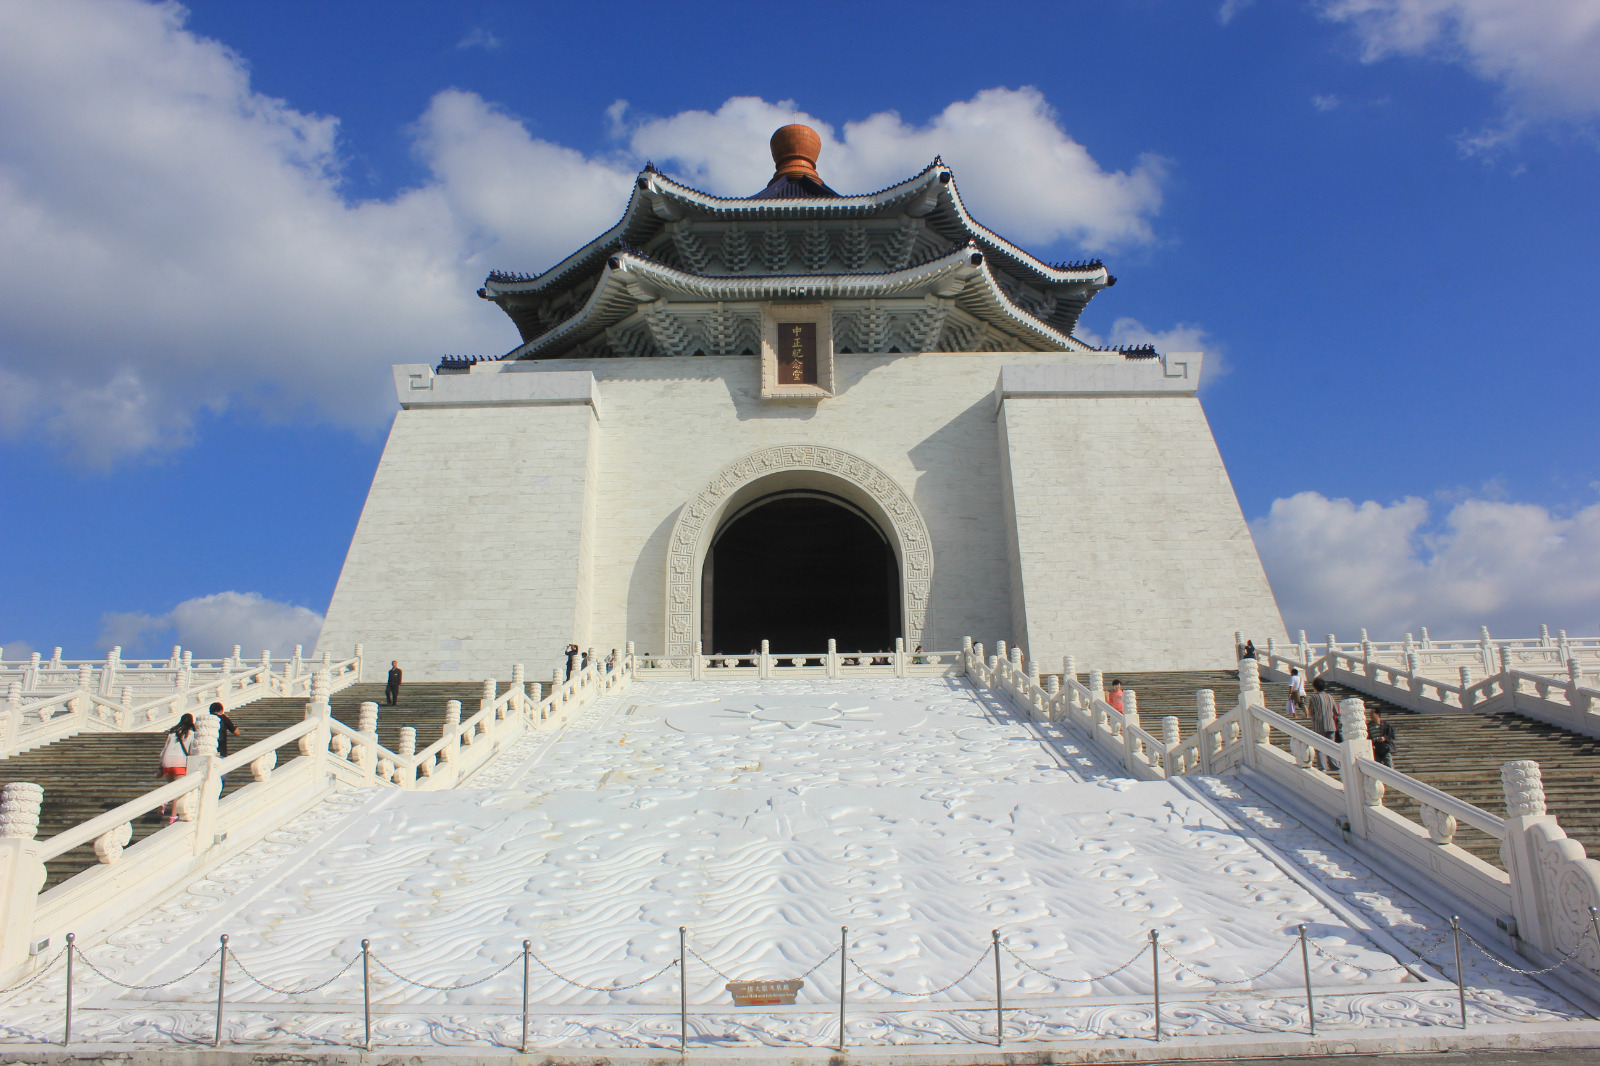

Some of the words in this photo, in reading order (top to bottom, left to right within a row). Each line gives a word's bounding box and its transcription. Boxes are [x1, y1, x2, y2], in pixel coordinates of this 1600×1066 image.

[792, 325, 804, 381] 中正紀念堂
